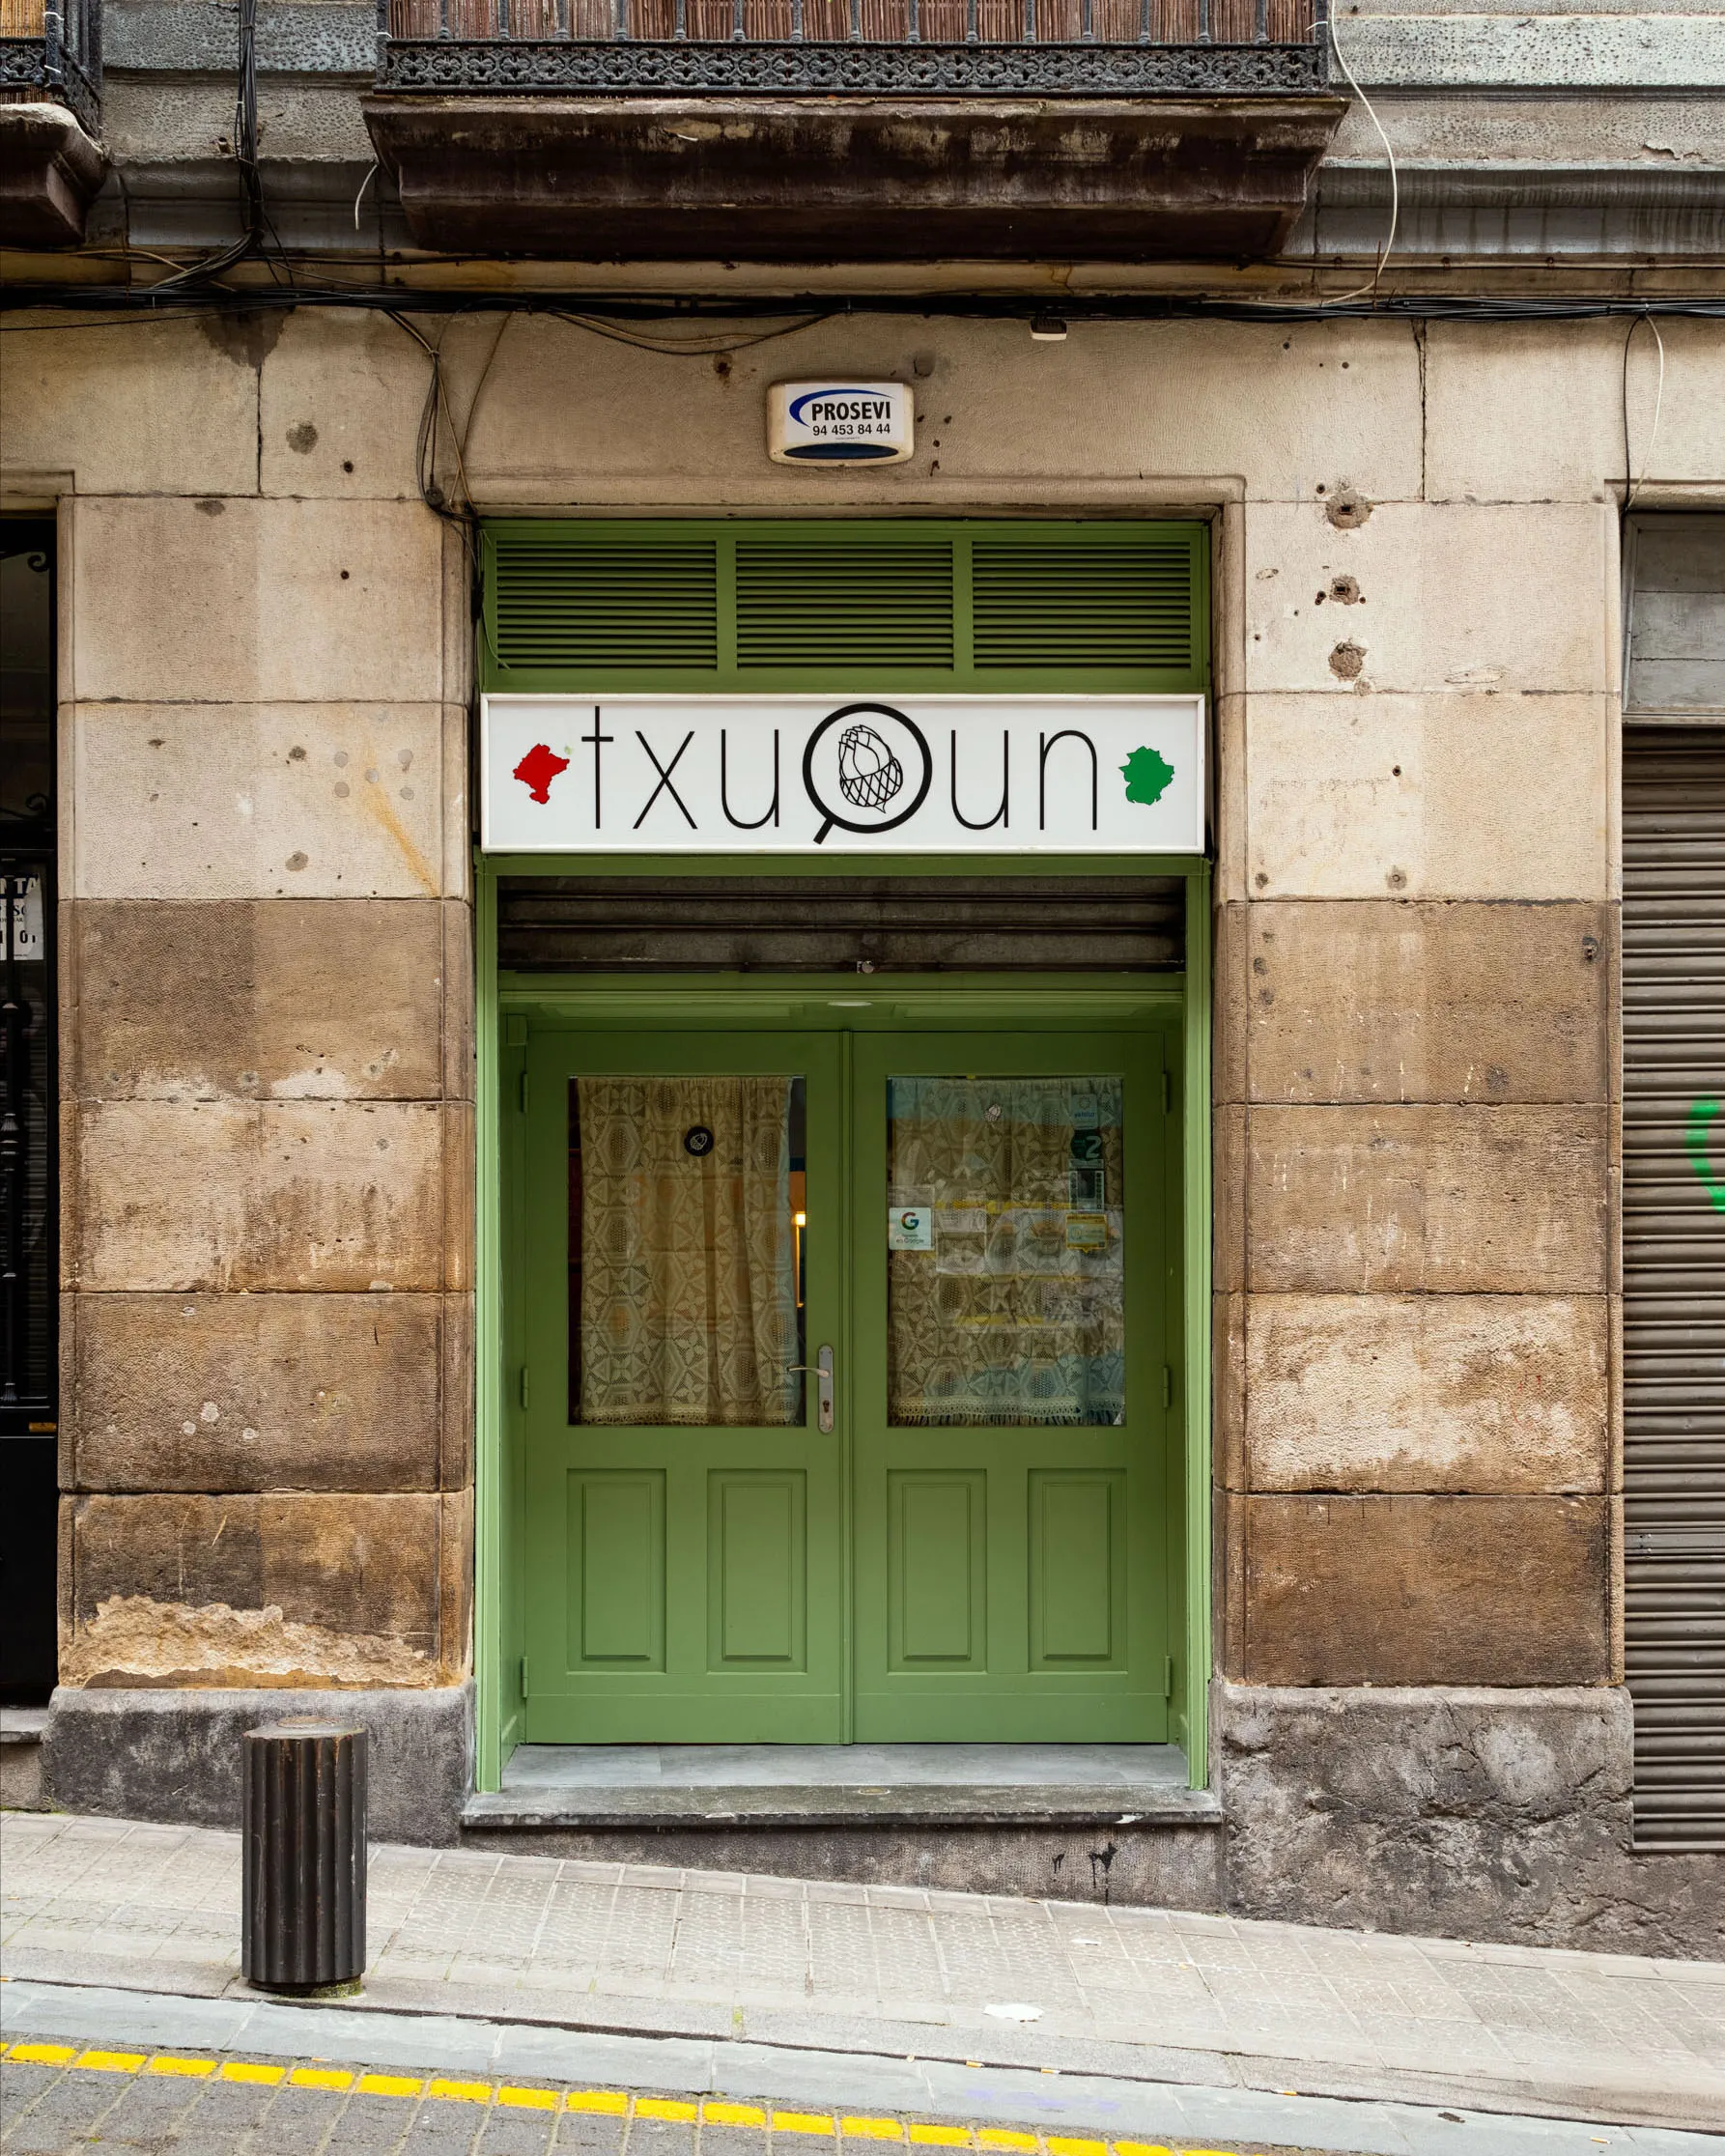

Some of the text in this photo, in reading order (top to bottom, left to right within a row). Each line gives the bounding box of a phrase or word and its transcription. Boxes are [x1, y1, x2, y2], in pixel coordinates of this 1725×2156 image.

[811, 401, 891, 421] PROSEVI
[812, 422, 891, 437] 94 453 84 44
